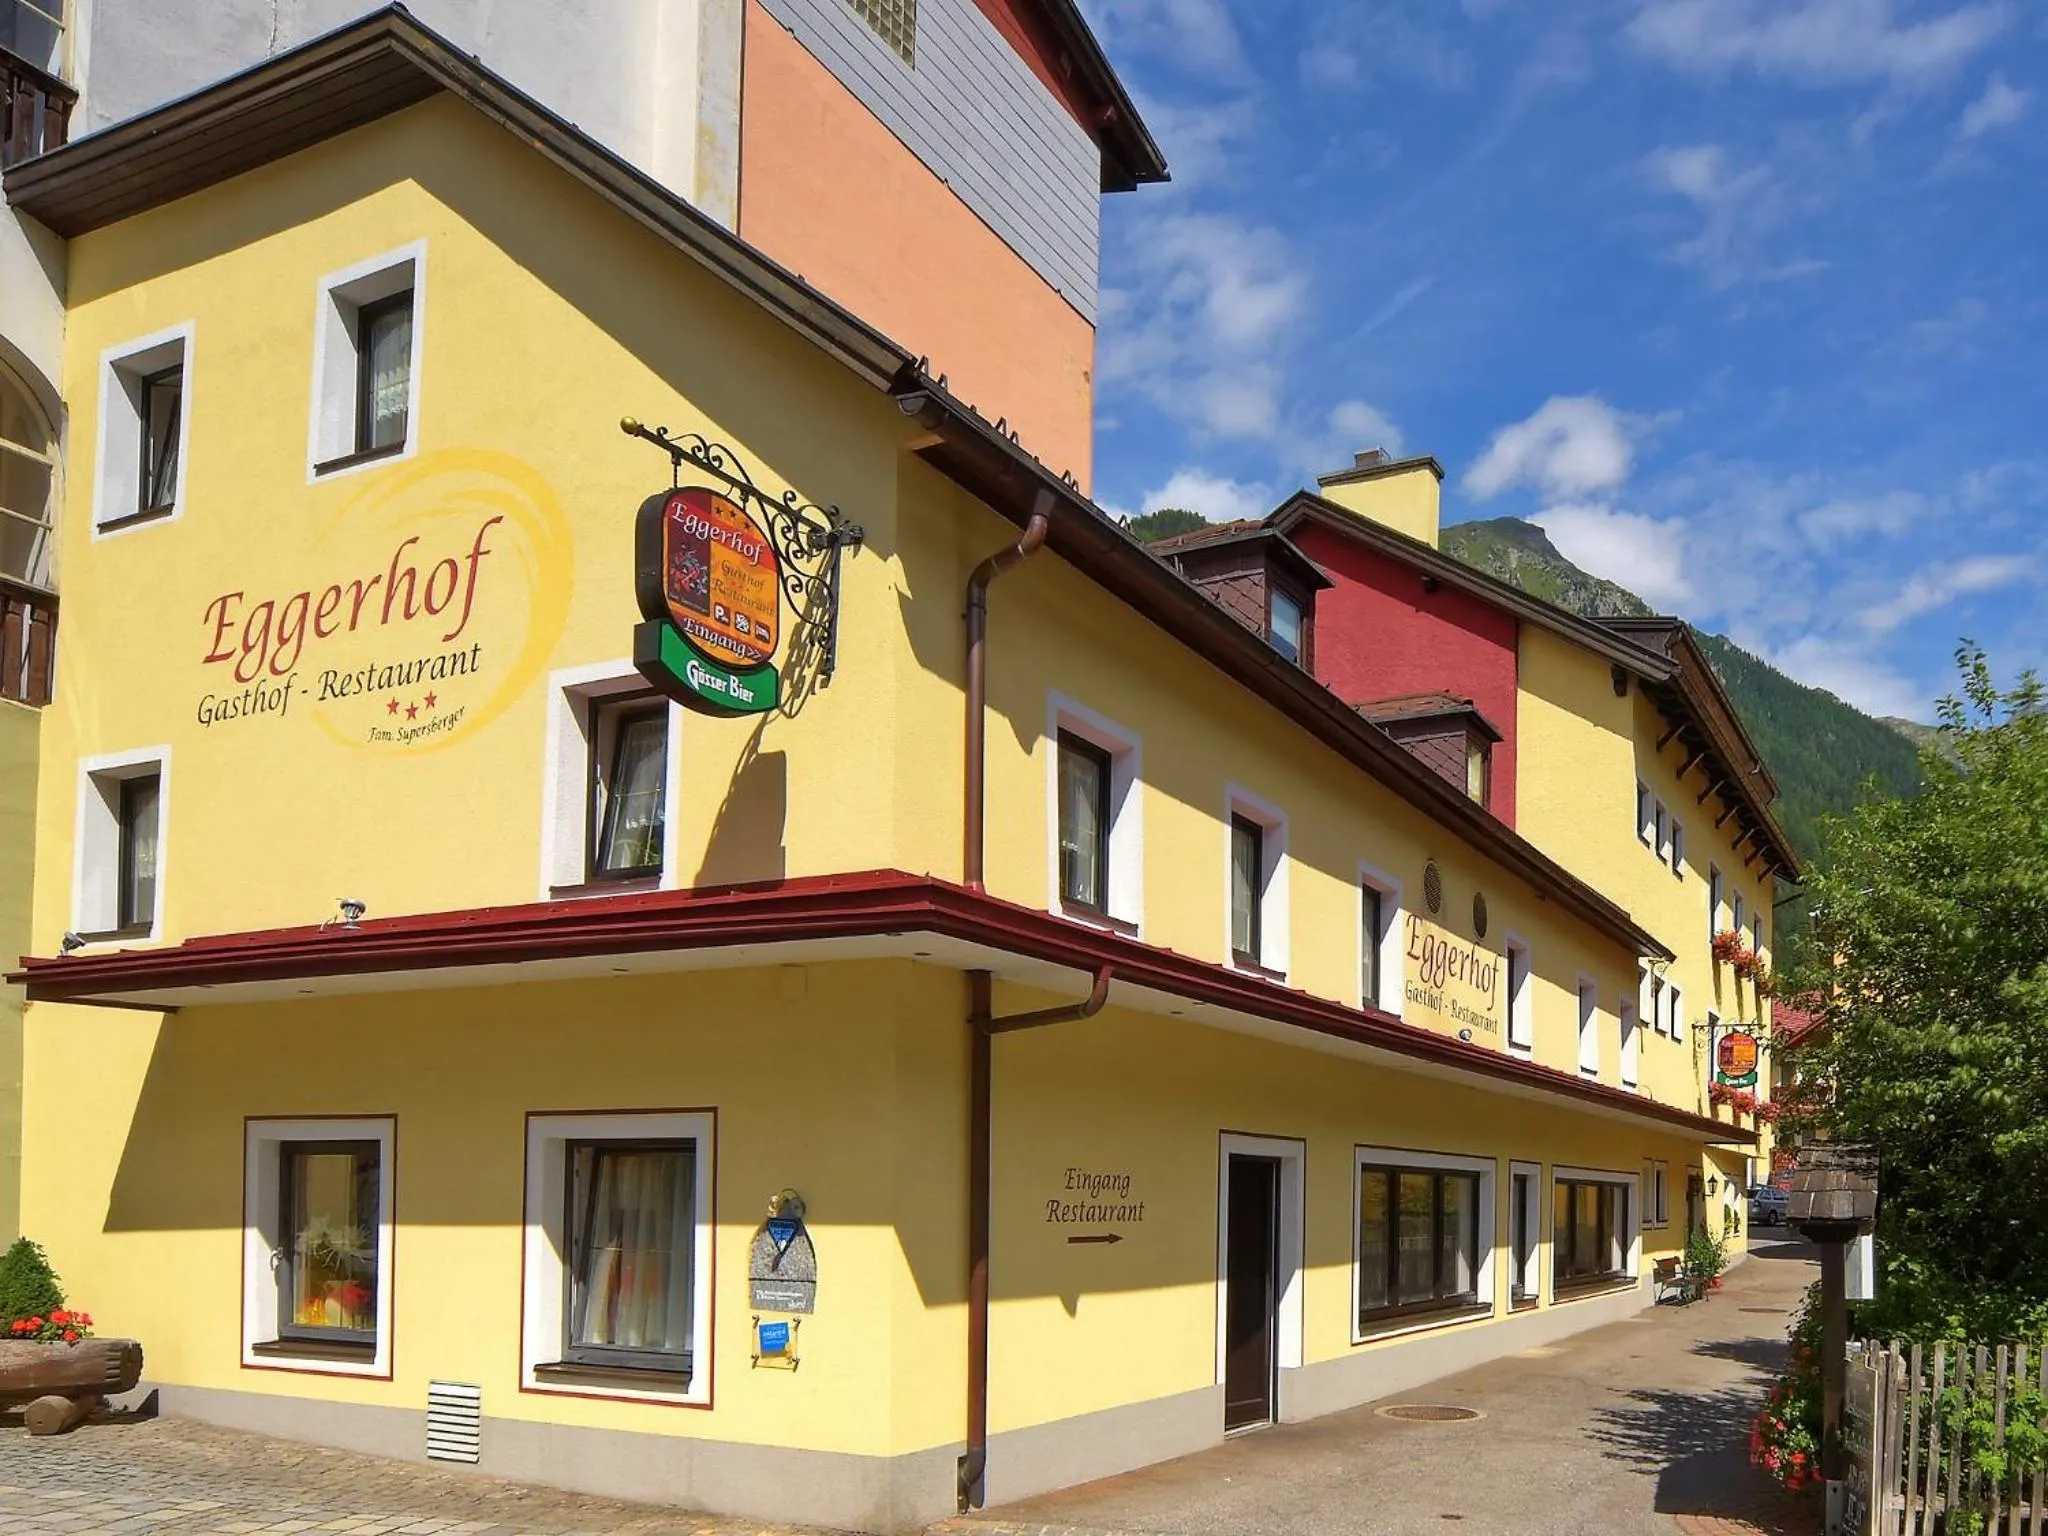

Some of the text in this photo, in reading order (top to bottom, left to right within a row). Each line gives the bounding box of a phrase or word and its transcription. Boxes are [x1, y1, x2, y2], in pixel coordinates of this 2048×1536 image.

[672, 502, 765, 565] Eggerhof
[202, 515, 504, 683] Eggerhof
[683, 617, 746, 658] Eingang
[197, 673, 297, 728] Gasthof
[318, 642, 482, 701] Restaurant
[686, 660, 754, 703] Gösser Bier
[1406, 914, 1500, 1012] Eggerhof
[1405, 979, 1444, 1016] Gasthof
[1451, 998, 1498, 1035] Restaurant
[1045, 1199, 1145, 1223] Restaurant
[1064, 1168, 1131, 1198] Eingang
